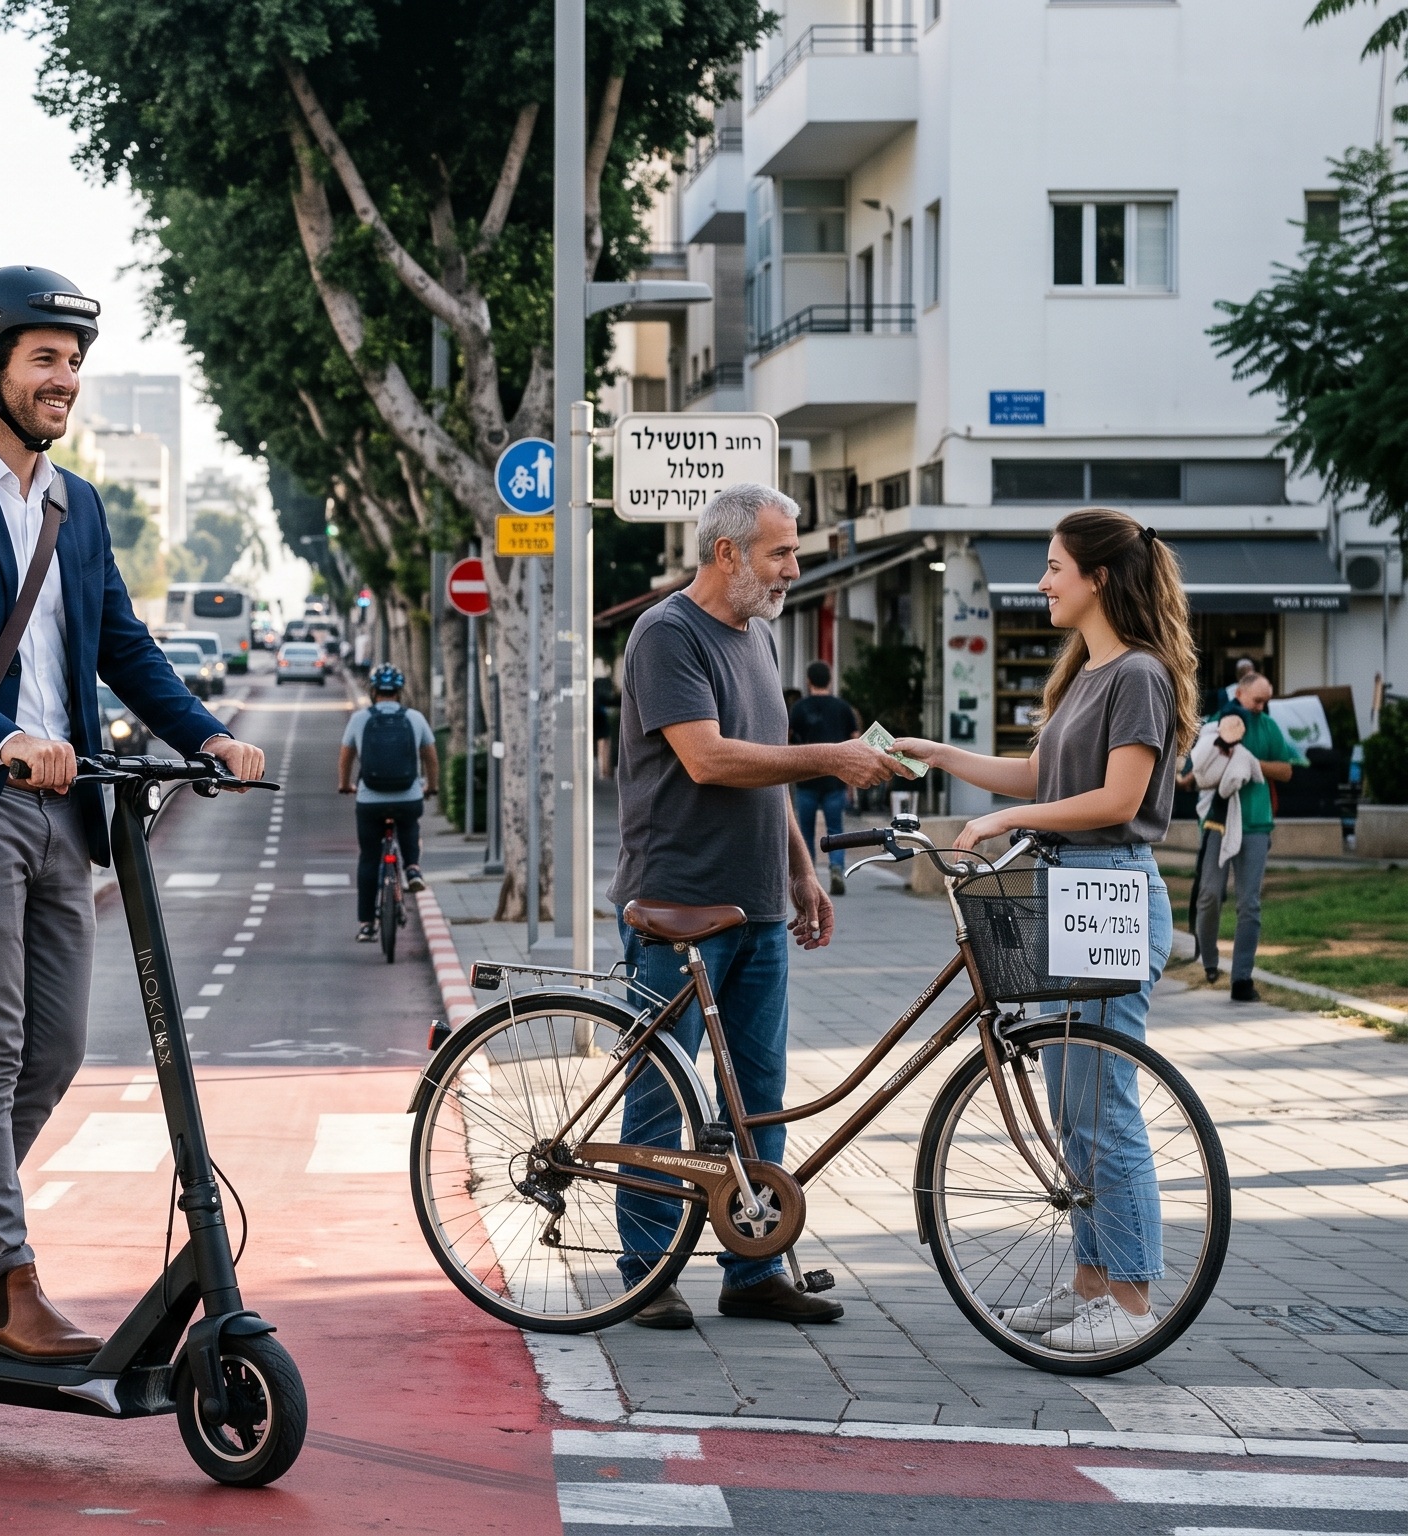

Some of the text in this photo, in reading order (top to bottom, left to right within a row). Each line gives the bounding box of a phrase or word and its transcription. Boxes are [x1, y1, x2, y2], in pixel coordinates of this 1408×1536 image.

[630, 426, 761, 450] רחוב רוטשילד
[667, 457, 724, 478] מטלול
[629, 489, 706, 511] וקורקינט
[1076, 879, 1140, 903] למכירה
